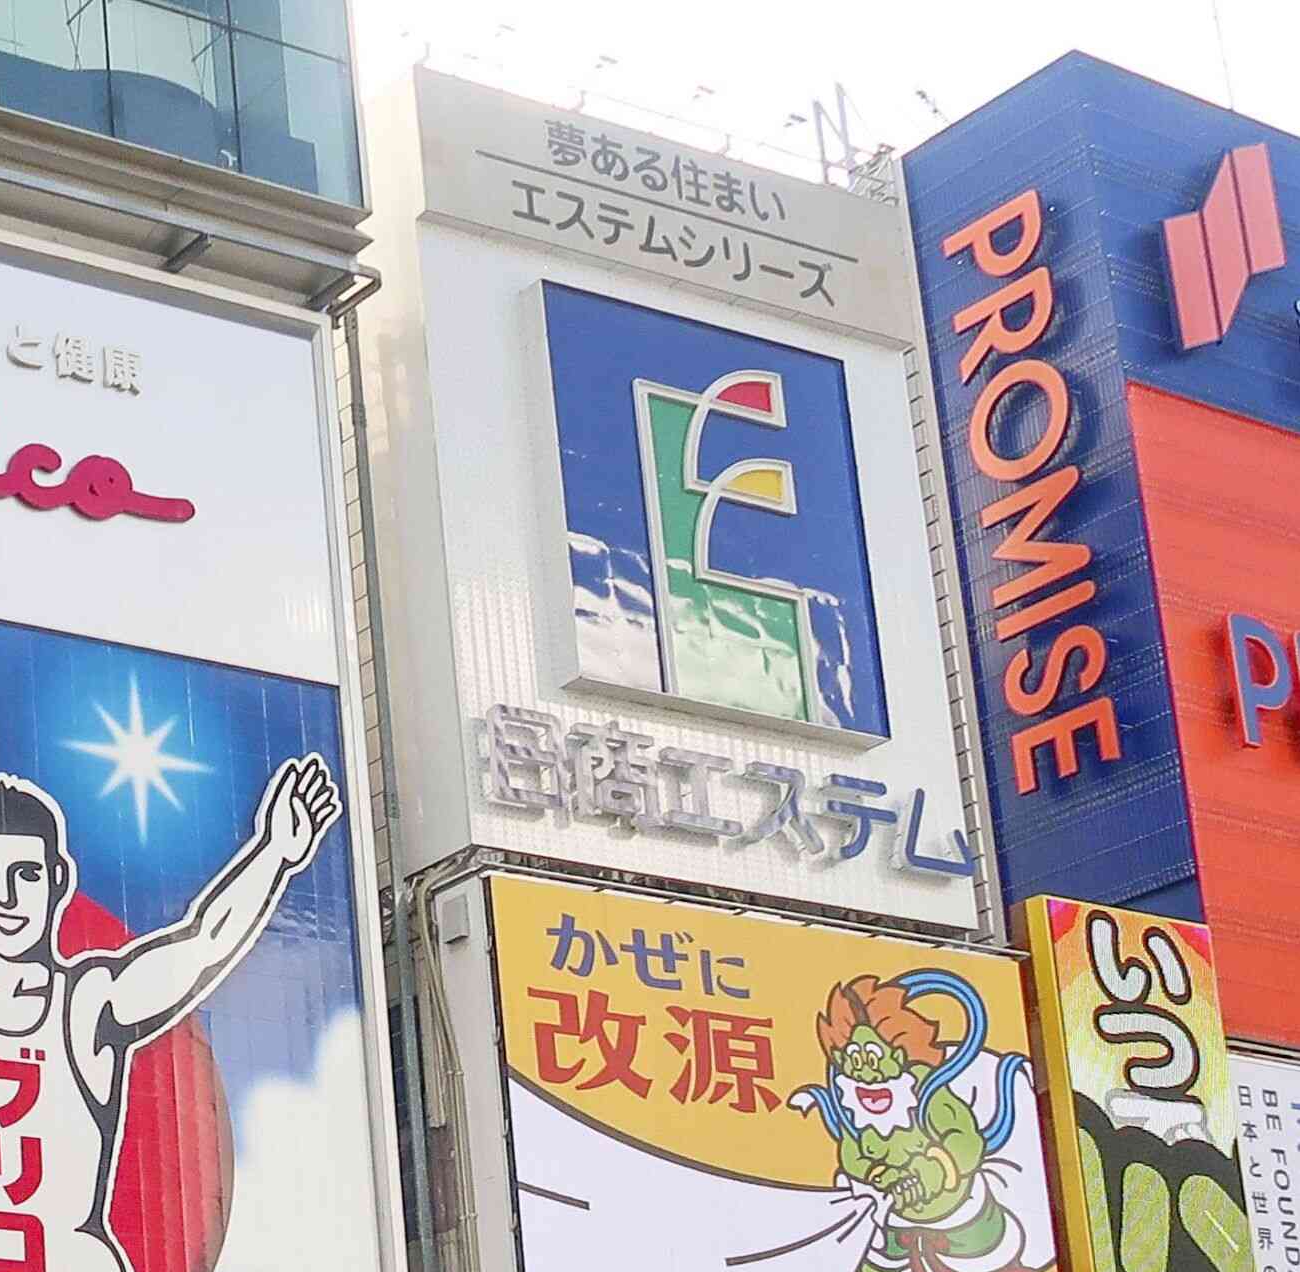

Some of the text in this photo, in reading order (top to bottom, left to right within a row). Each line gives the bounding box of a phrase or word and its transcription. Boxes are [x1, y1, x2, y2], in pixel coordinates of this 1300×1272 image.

[545, 119, 786, 222] 夢ある住まい
[512, 179, 835, 306] エステムシリーズ
[942, 188, 1120, 796] PROMISE
[547, 912, 751, 999] かぜに
[527, 987, 788, 1114] 改源
